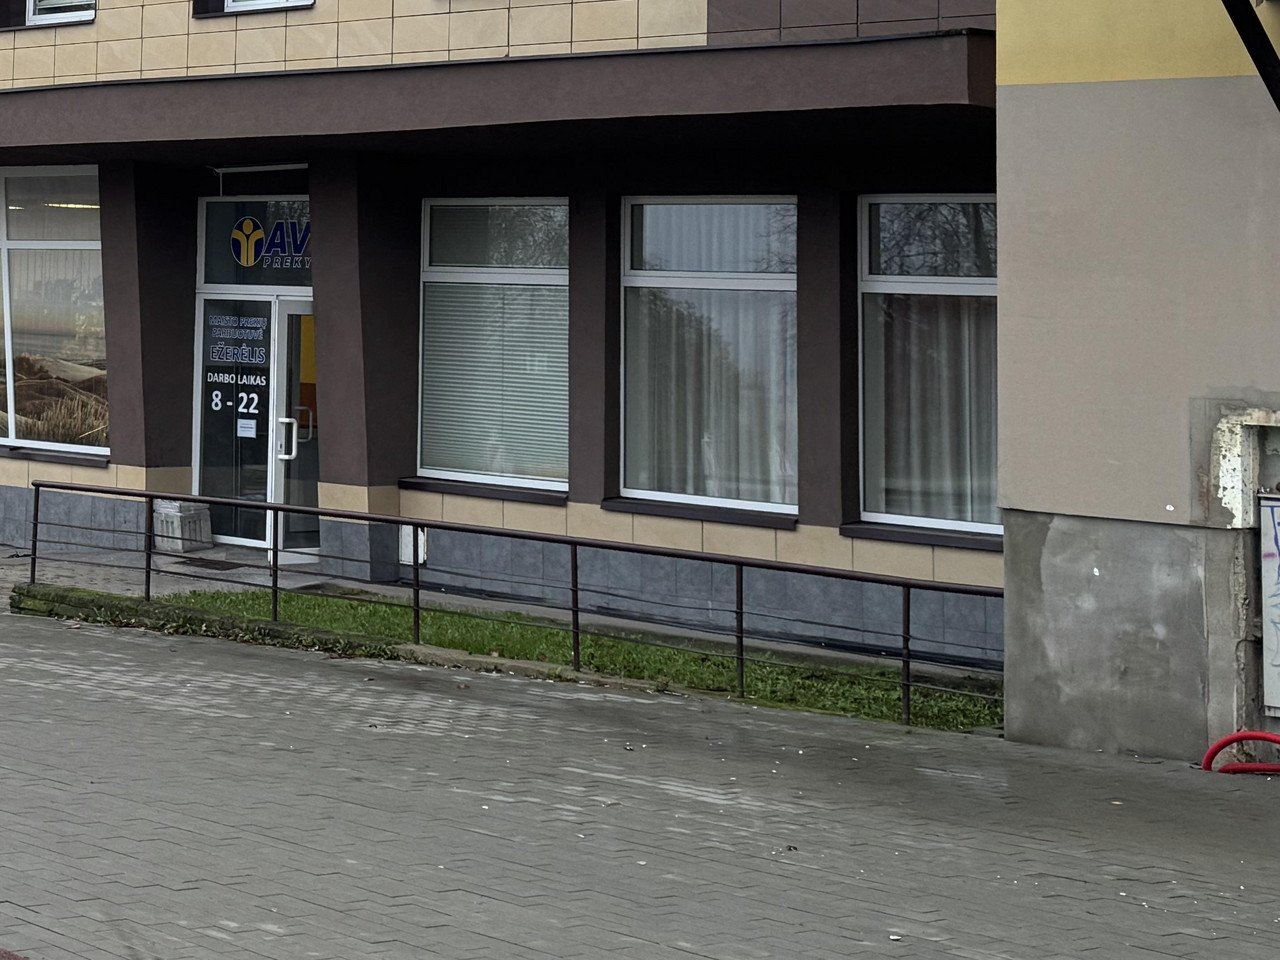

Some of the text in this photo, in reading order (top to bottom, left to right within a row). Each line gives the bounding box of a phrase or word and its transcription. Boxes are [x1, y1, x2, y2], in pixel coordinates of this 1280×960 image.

[262, 220, 311, 256] AV
[263, 257, 312, 268] PREKY
[210, 341, 266, 364] EŽERĖLIS
[207, 372, 267, 386] DARBO LAIKAS
[211, 390, 222, 411] 8
[237, 392, 259, 414] 22
